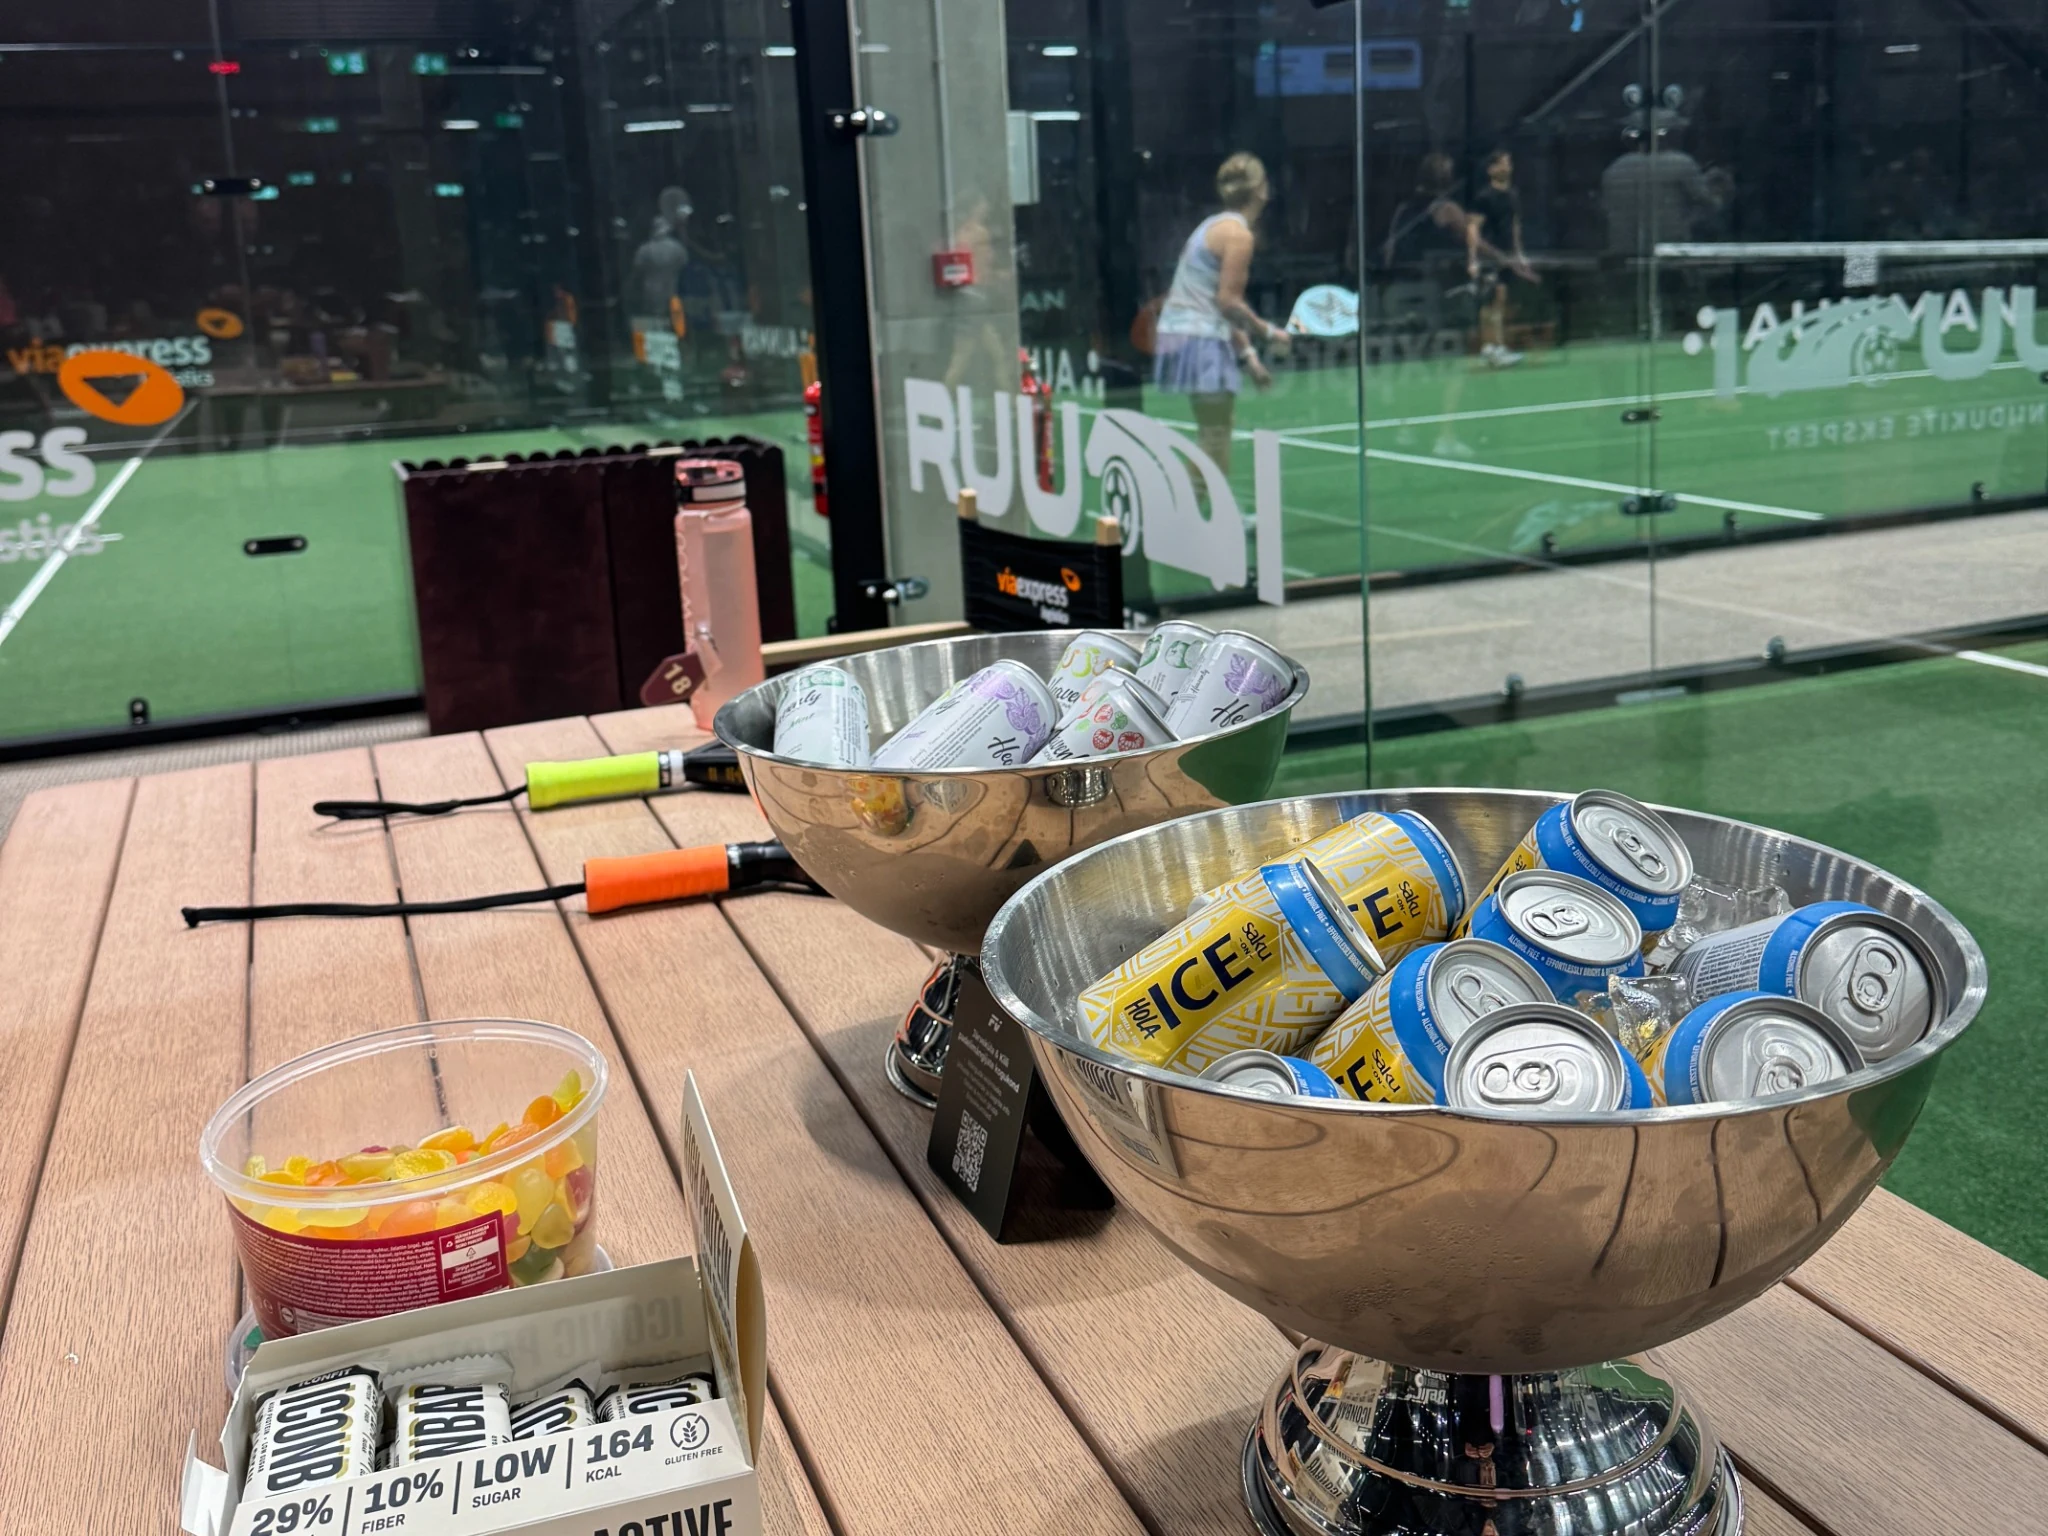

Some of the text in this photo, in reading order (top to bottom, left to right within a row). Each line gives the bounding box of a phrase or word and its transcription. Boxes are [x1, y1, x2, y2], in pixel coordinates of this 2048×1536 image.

[663, 662, 692, 695] 18
[1525, 945, 1541, 961] FREE
[1147, 932, 1255, 1031] ICE
[1124, 997, 1162, 1040] HOLA
[1433, 1037, 1449, 1057] FREE
[266, 1382, 352, 1492] ICONB
[664, 1445, 724, 1467] GLUTEN FREE
[250, 1423, 655, 1536] 29% 10% LOW 164
[586, 1465, 623, 1484] KCAL
[472, 1487, 521, 1509] SUGAR
[361, 1513, 406, 1535] FIBER
